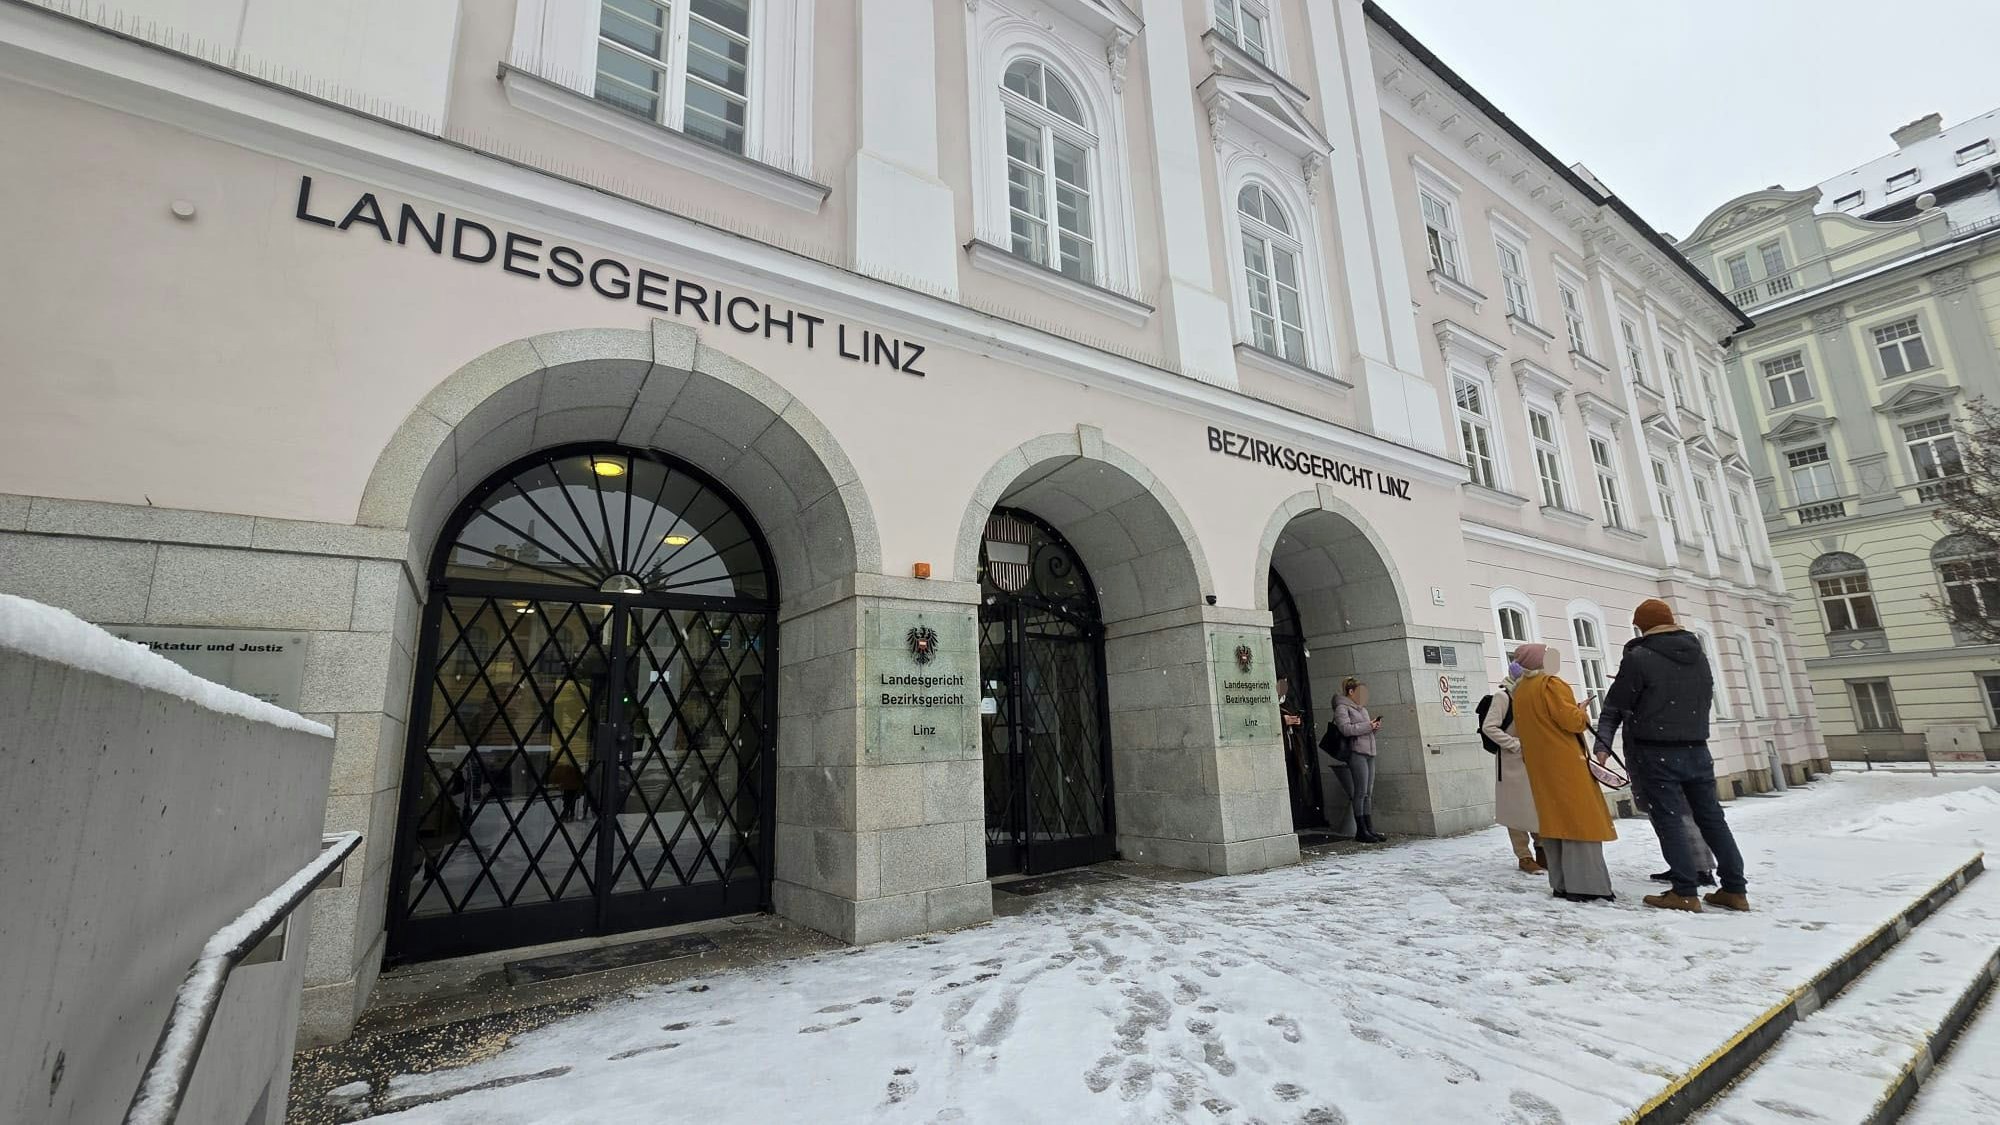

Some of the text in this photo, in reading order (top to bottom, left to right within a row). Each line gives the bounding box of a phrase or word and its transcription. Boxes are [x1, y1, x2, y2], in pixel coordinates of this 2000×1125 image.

[296, 175, 926, 377] LANDESGERICHT LINZ
[1207, 426, 1412, 501] BEZIRKSGERICHT LINZ
[207, 643, 235, 651] und
[239, 643, 284, 652] Justiz
[881, 673, 964, 688] Landesgericht
[1224, 680, 1270, 691] Landesgericht
[881, 693, 964, 707] Bezirksgericht
[1225, 695, 1271, 706] Bezirksgericht
[1244, 718, 1258, 727] Linz
[913, 725, 936, 735] Linz
